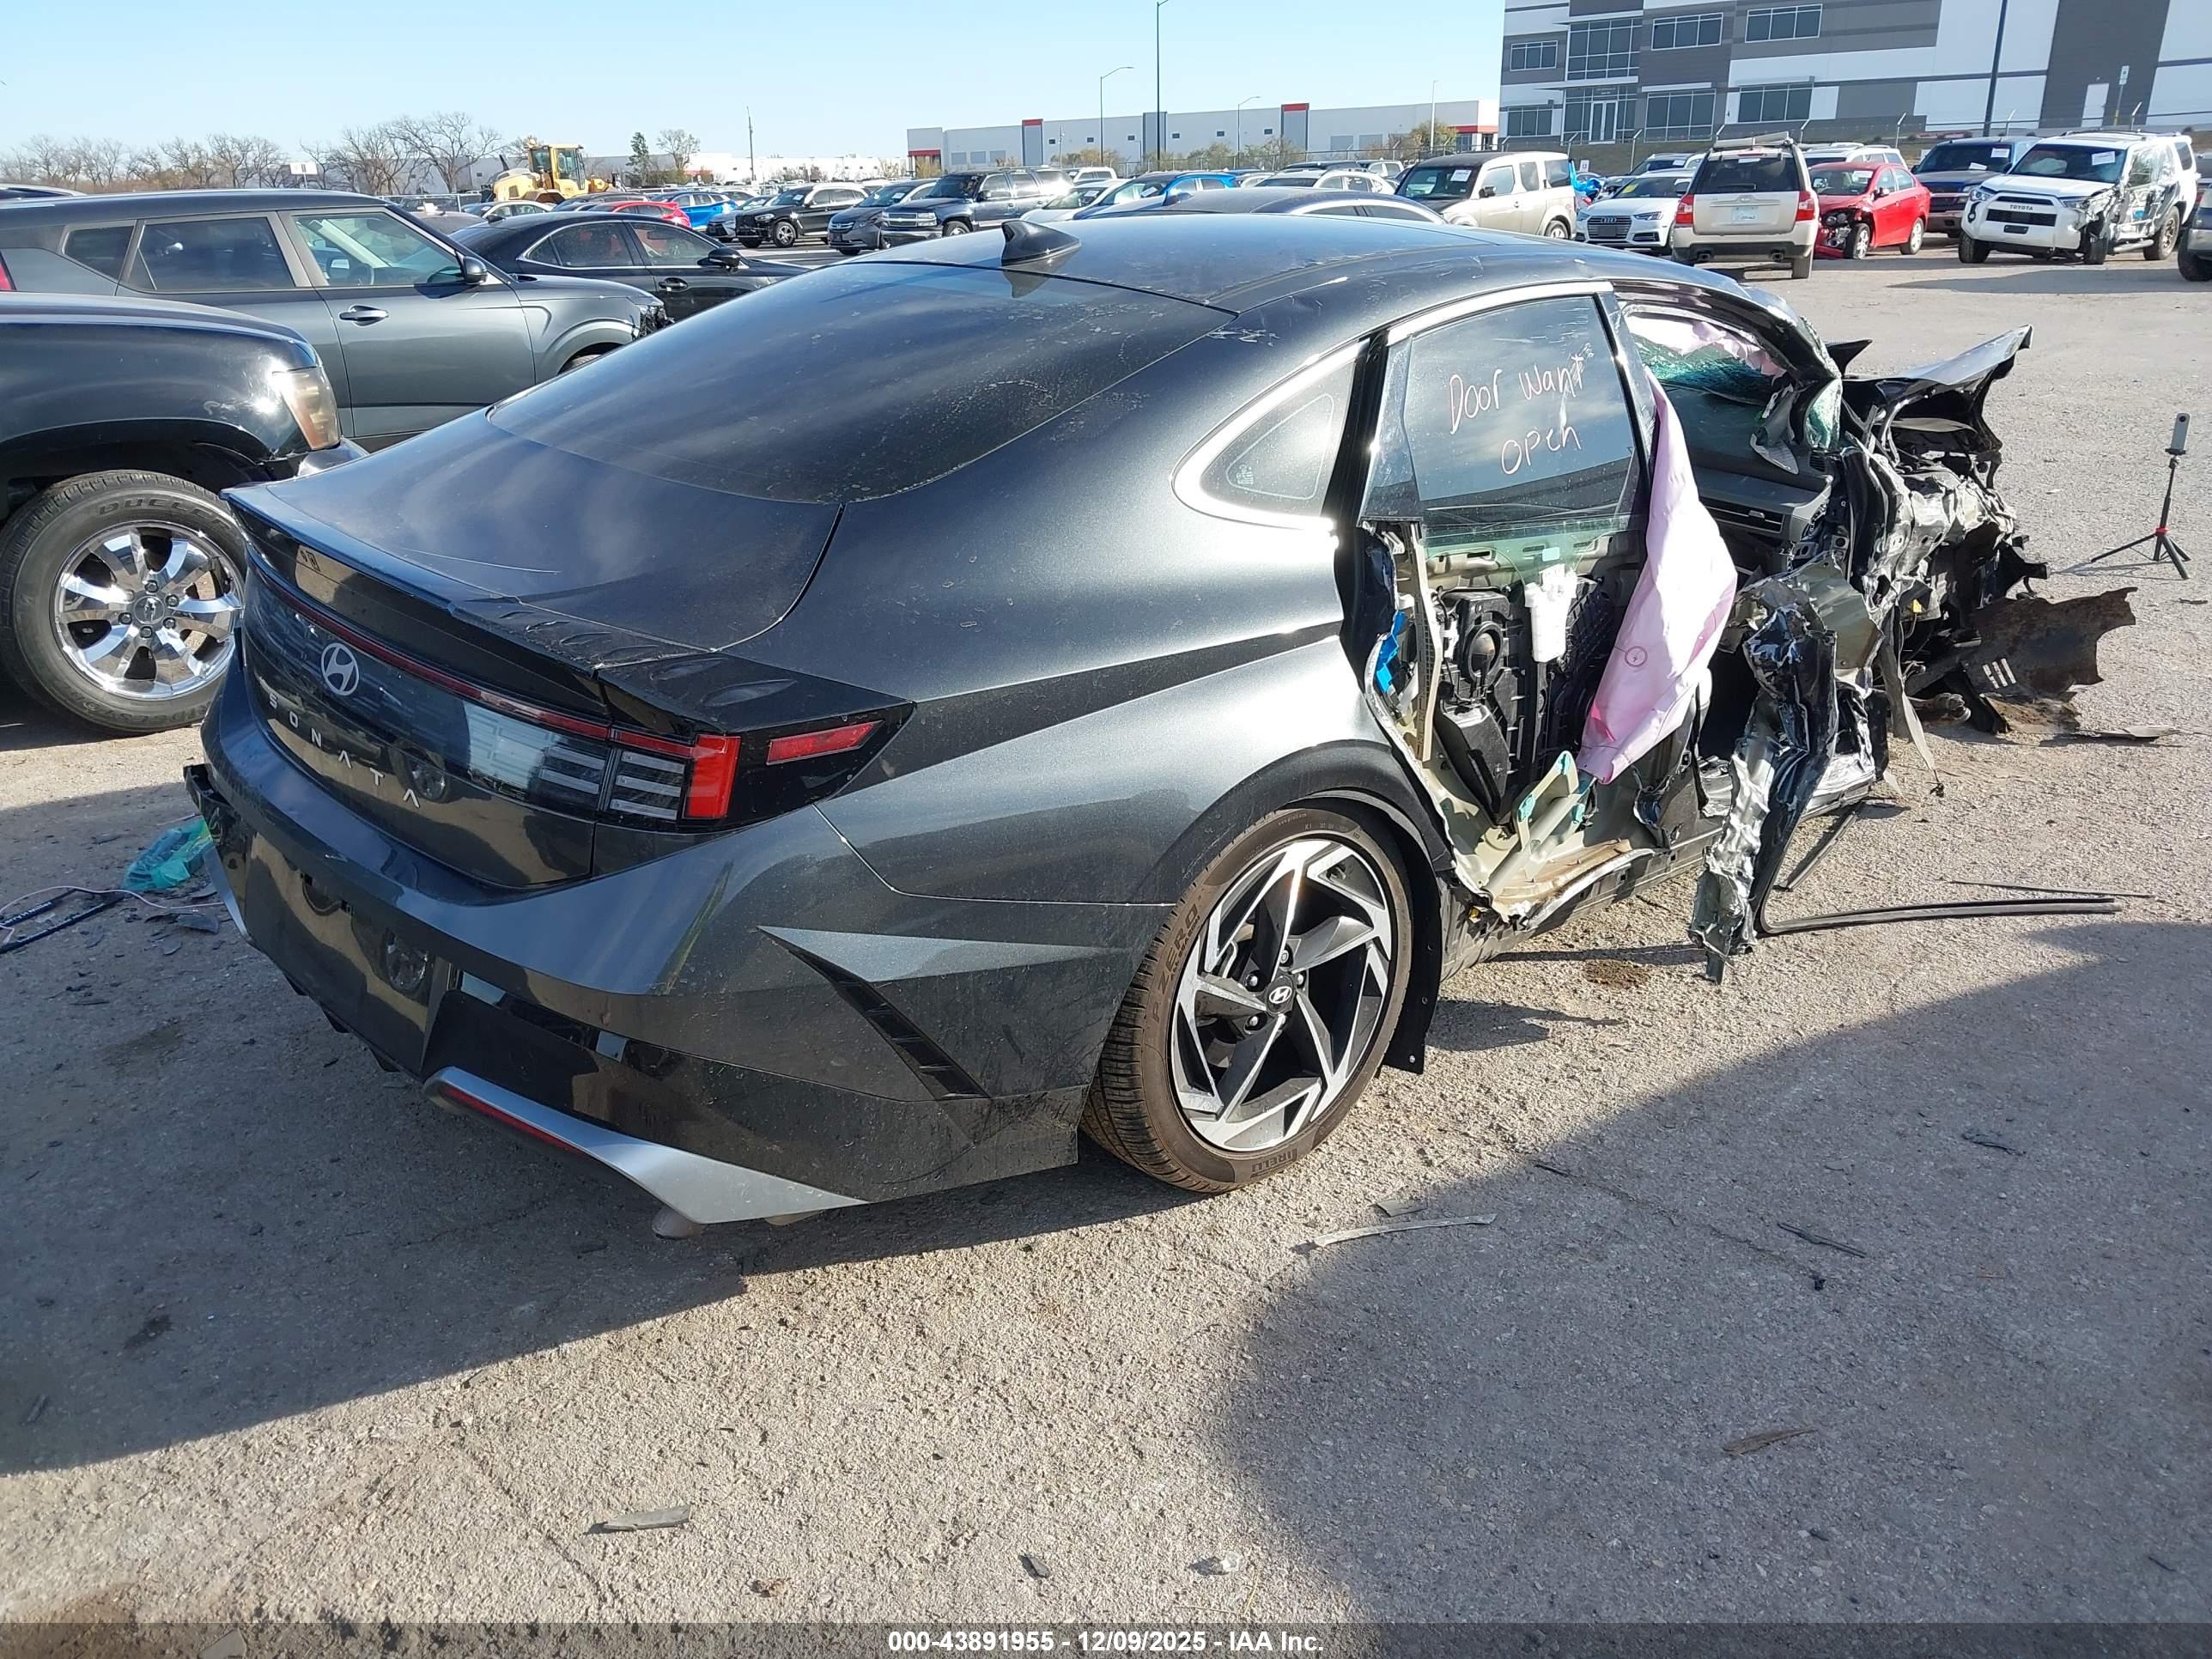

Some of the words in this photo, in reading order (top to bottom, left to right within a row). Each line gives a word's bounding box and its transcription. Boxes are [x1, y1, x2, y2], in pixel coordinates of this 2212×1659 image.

[1449, 368, 1503, 434] Door
[269, 693, 420, 808] SONATA
[1158, 903, 1198, 994] ZERO
